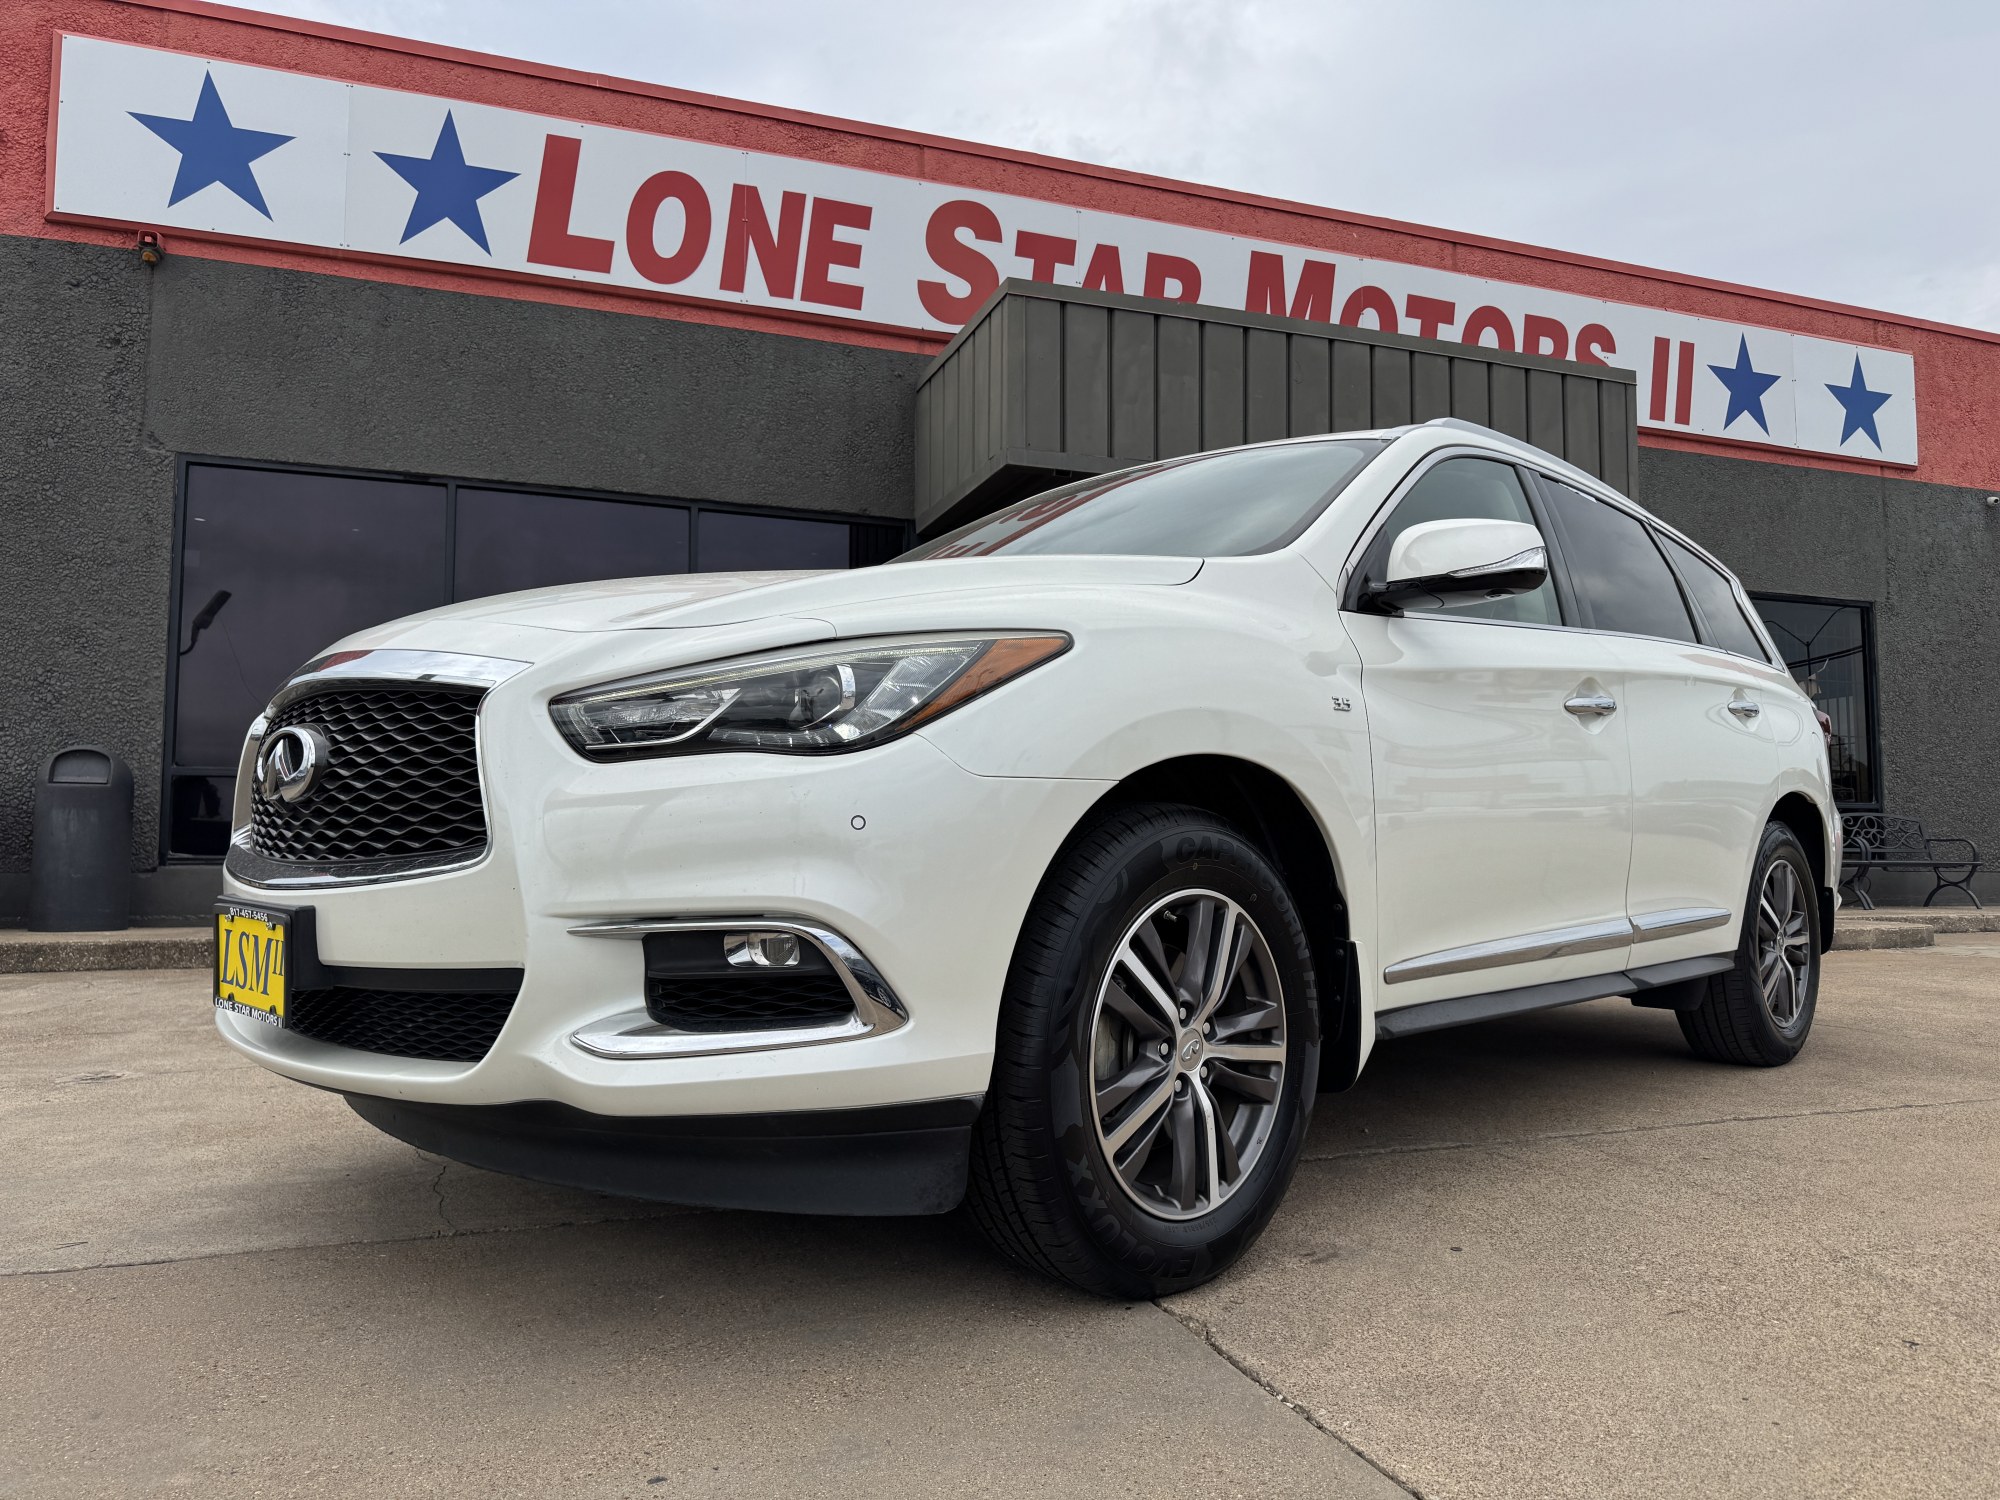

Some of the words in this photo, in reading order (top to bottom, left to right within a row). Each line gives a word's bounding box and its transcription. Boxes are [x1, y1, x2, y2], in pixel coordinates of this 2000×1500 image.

[526, 133, 873, 311] LONE
[1649, 336, 1695, 426] II
[229, 907, 268, 922] 817-457-5456
[215, 998, 233, 1011] LONE
[234, 1003, 250, 1016] STAR
[251, 1008, 278, 1026] MOTORS
